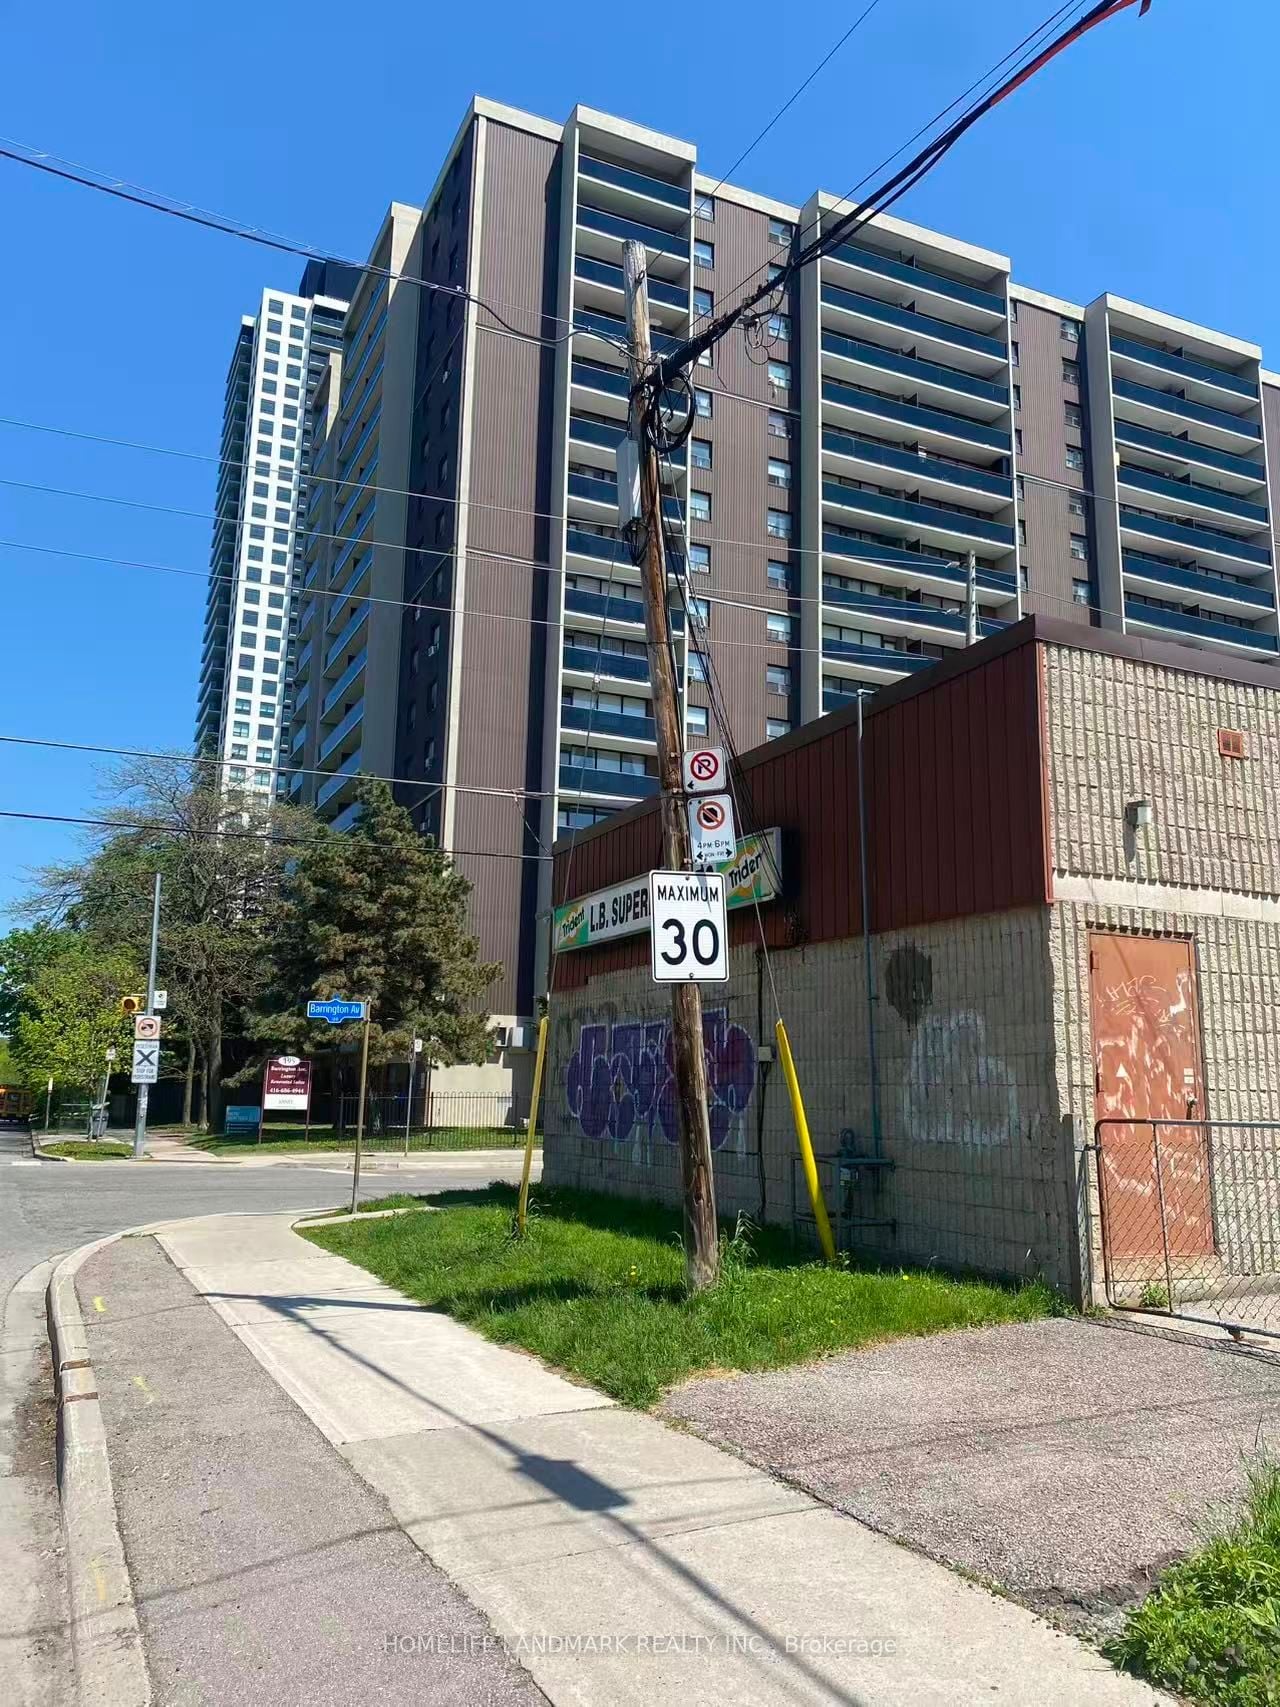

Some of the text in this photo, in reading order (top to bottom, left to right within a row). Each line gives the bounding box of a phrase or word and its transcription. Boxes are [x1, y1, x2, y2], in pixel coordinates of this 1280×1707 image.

[657, 885, 719, 902] MAXIMUM
[562, 907, 585, 937] Trident
[590, 901, 609, 932] L.B.
[661, 918, 720, 966] 30
[310, 1003, 360, 1016] Barrington Av
[271, 1065, 297, 1073] Barrington
